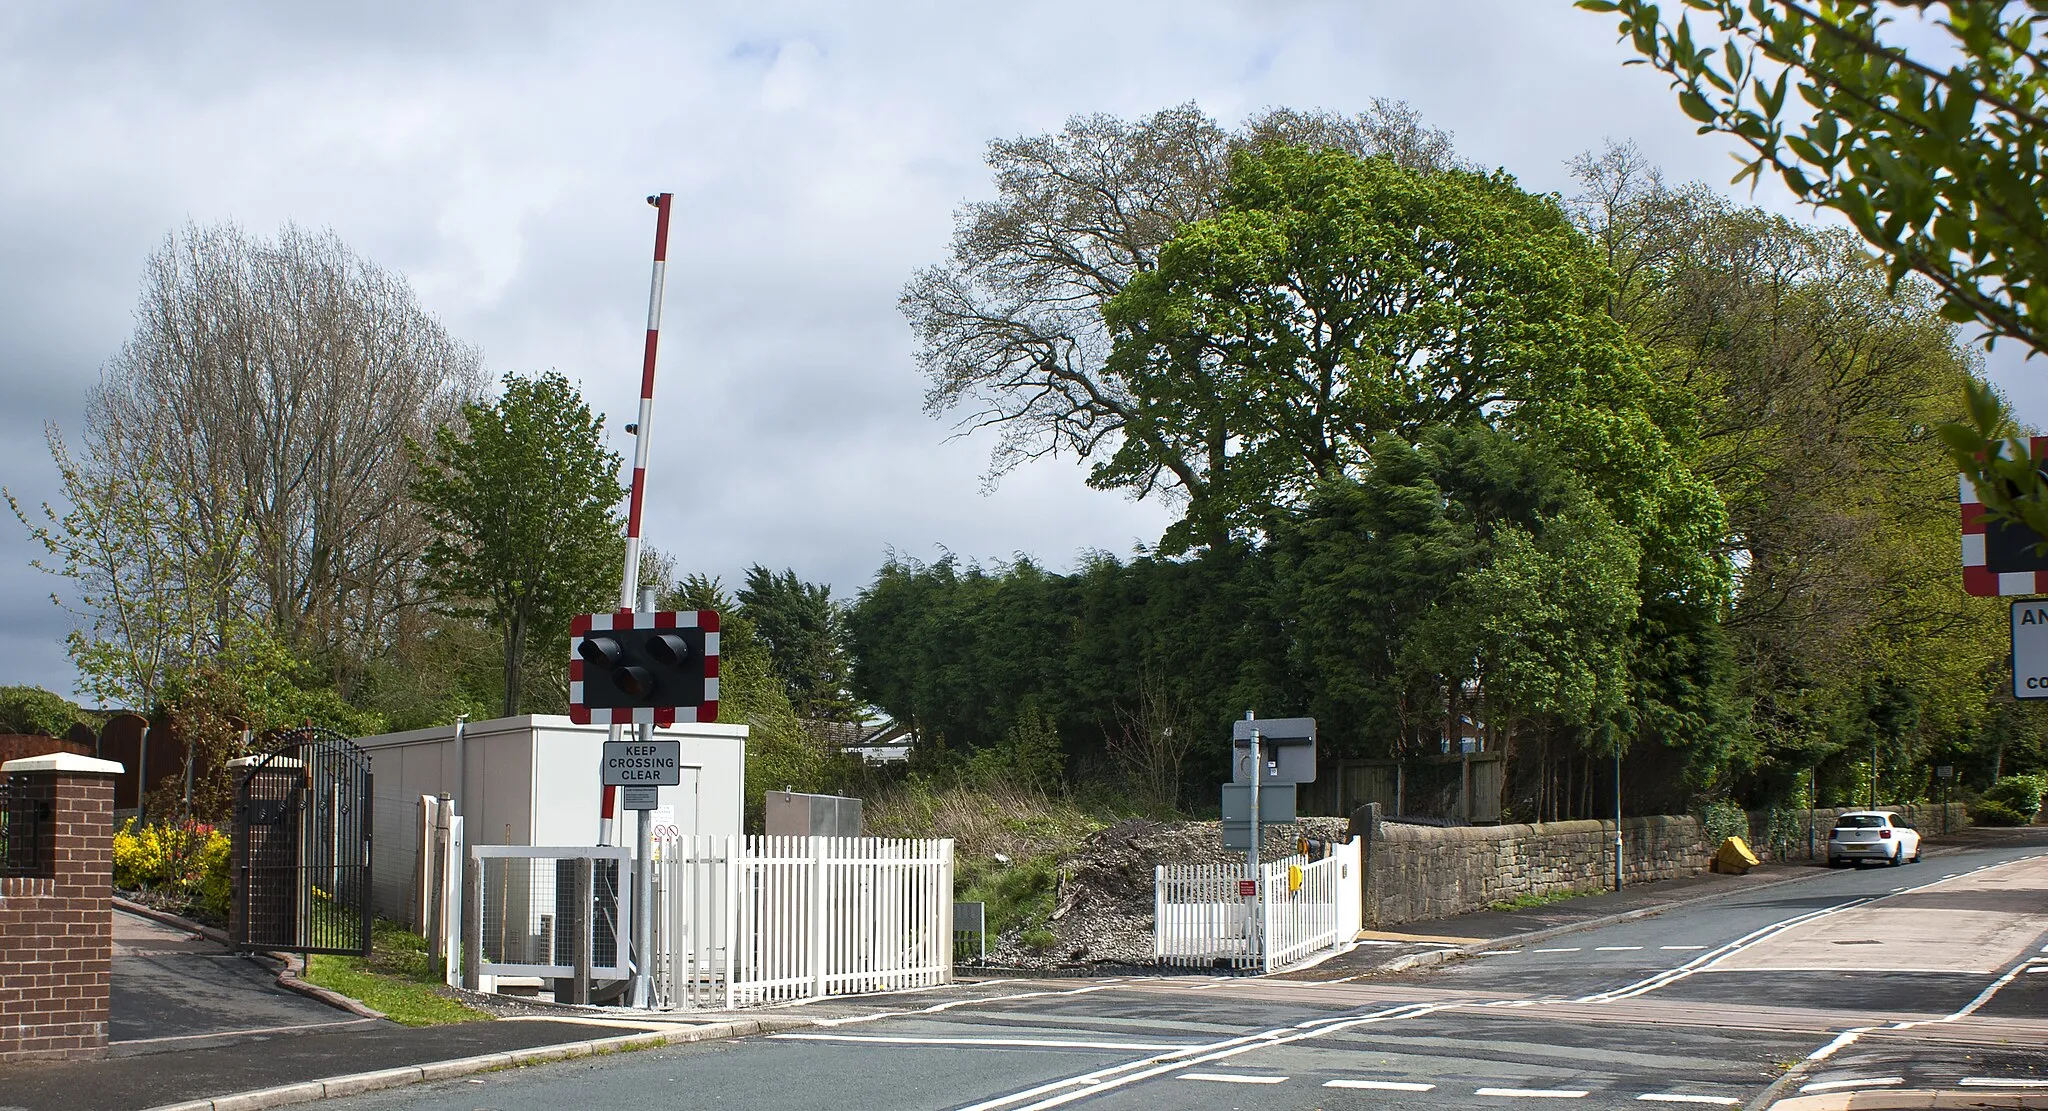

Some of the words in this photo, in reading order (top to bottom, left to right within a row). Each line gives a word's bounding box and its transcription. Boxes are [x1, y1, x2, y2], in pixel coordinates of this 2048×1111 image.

[626, 746, 657, 756] KEEP
[609, 758, 674, 768] CROSSING
[621, 770, 661, 780] CLEAR
